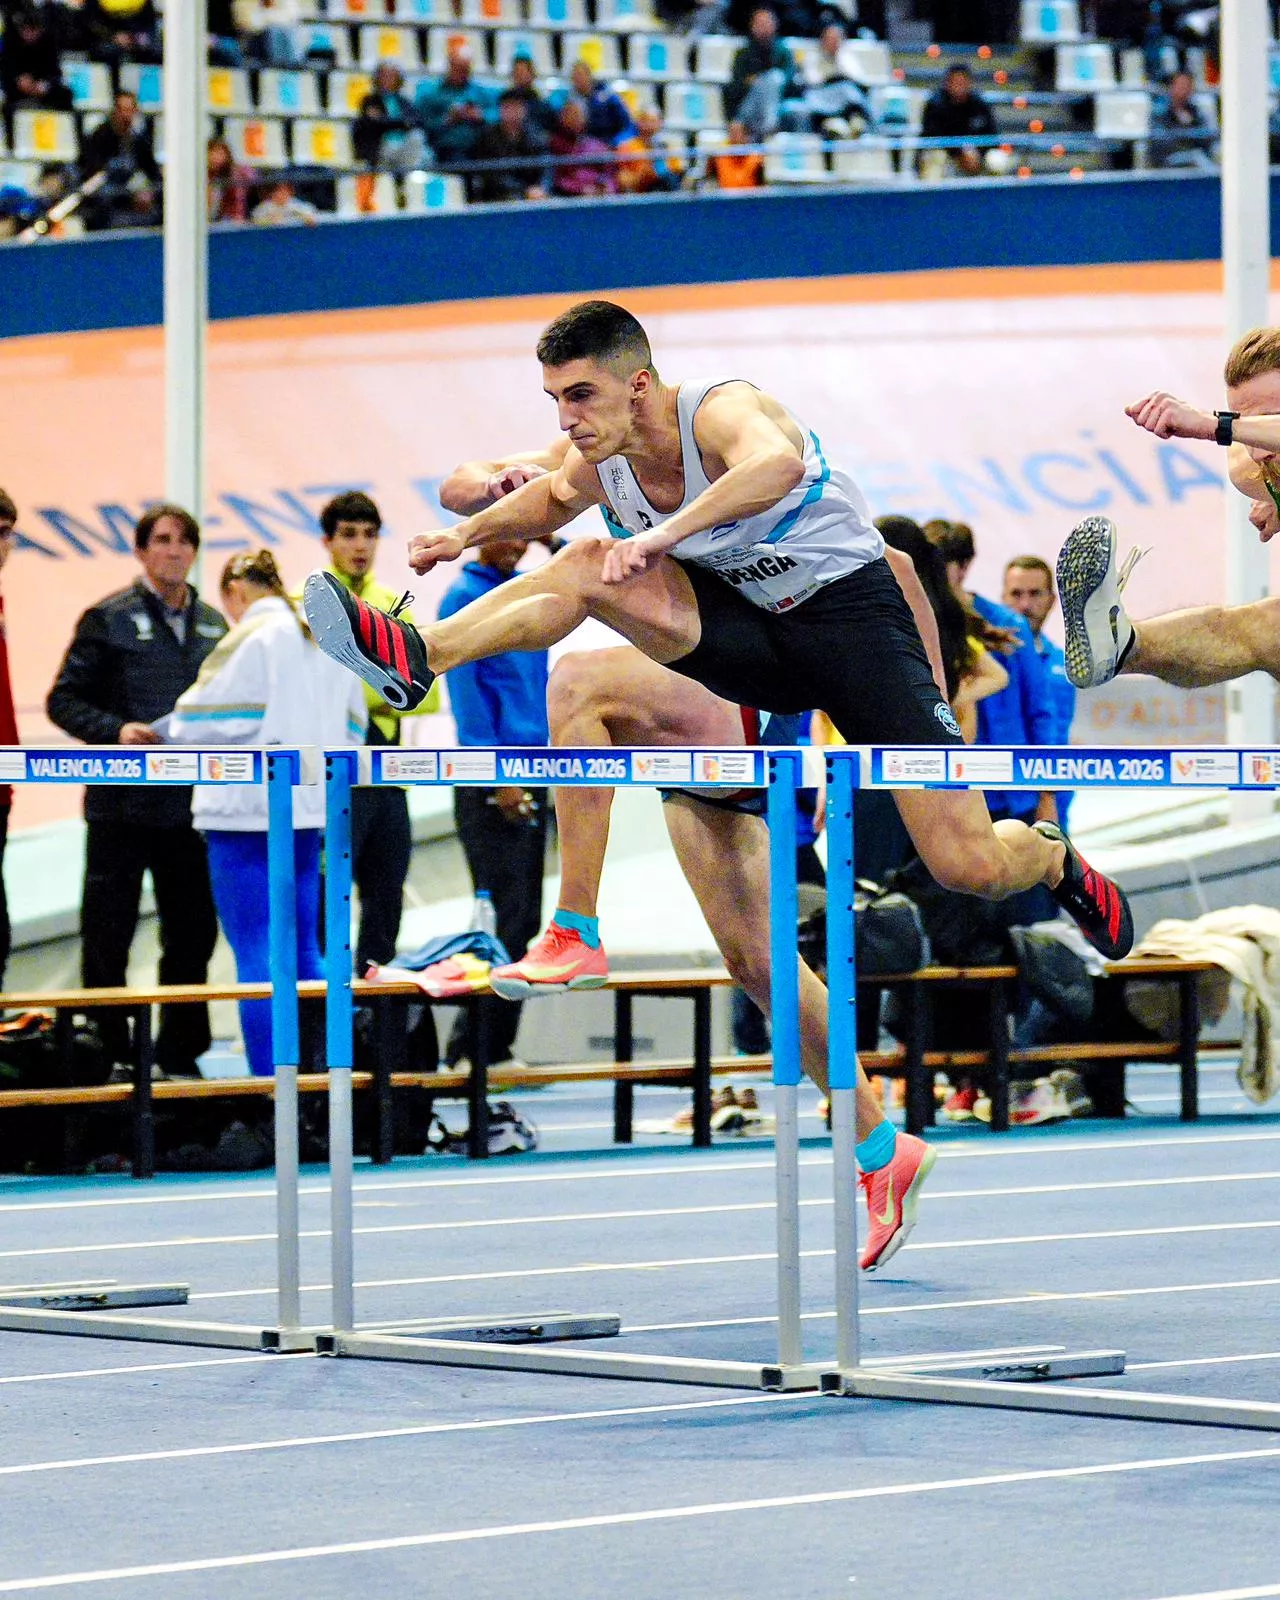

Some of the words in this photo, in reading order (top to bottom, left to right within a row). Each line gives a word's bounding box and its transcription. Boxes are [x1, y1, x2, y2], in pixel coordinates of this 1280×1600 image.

[30, 758, 104, 778] VALENCIA
[105, 758, 141, 778] 2026
[500, 758, 584, 778] VALENCIA
[585, 758, 626, 778] 2026
[1019, 758, 1114, 780] VALENCIA
[1118, 759, 1164, 781] 2026
